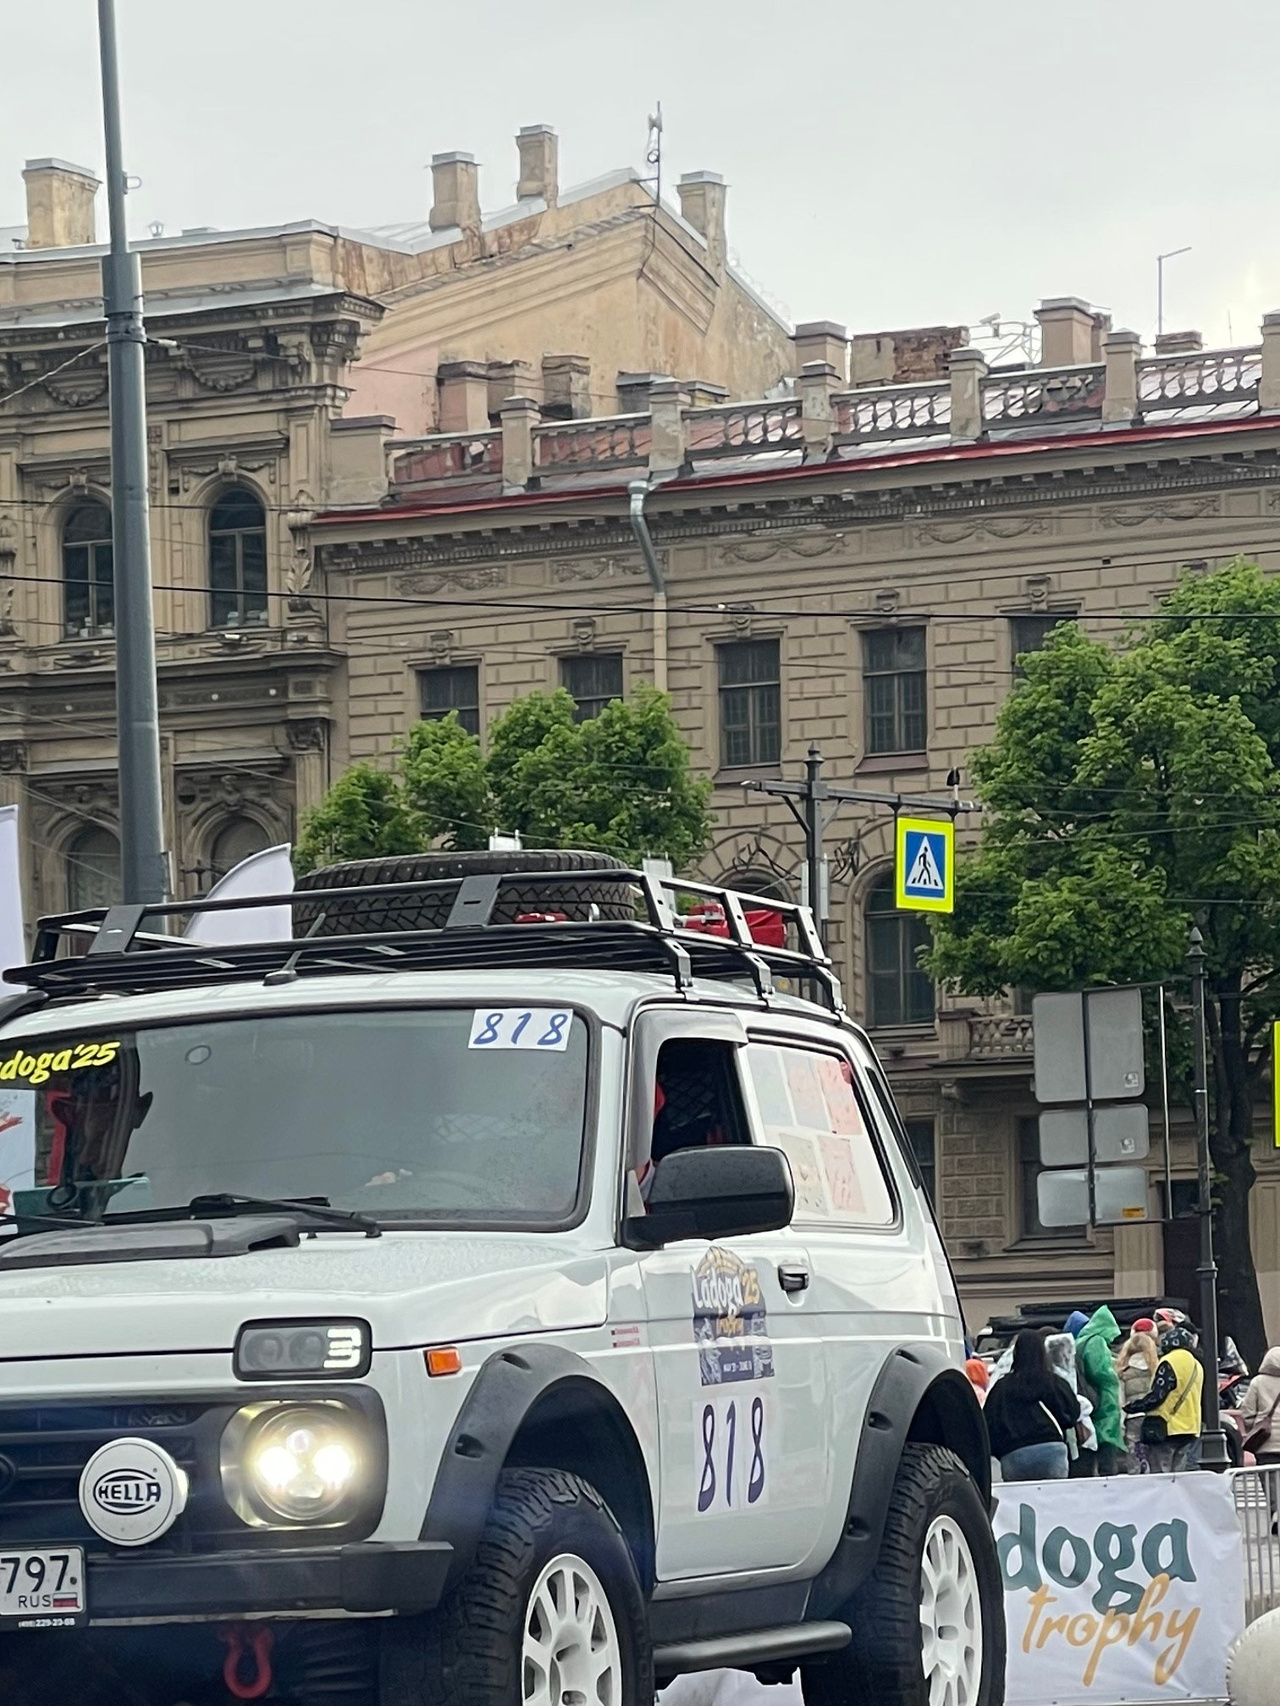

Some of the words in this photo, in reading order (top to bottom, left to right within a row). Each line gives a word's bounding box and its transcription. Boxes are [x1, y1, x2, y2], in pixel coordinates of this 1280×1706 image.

[473, 1012, 568, 1046] 818
[698, 1397, 765, 1512] 818
[98, 1482, 161, 1504] HELLA
[1, 1554, 69, 1594] 797
[18, 1594, 52, 1608] RUS
[1022, 1573, 1201, 1687] trophy
